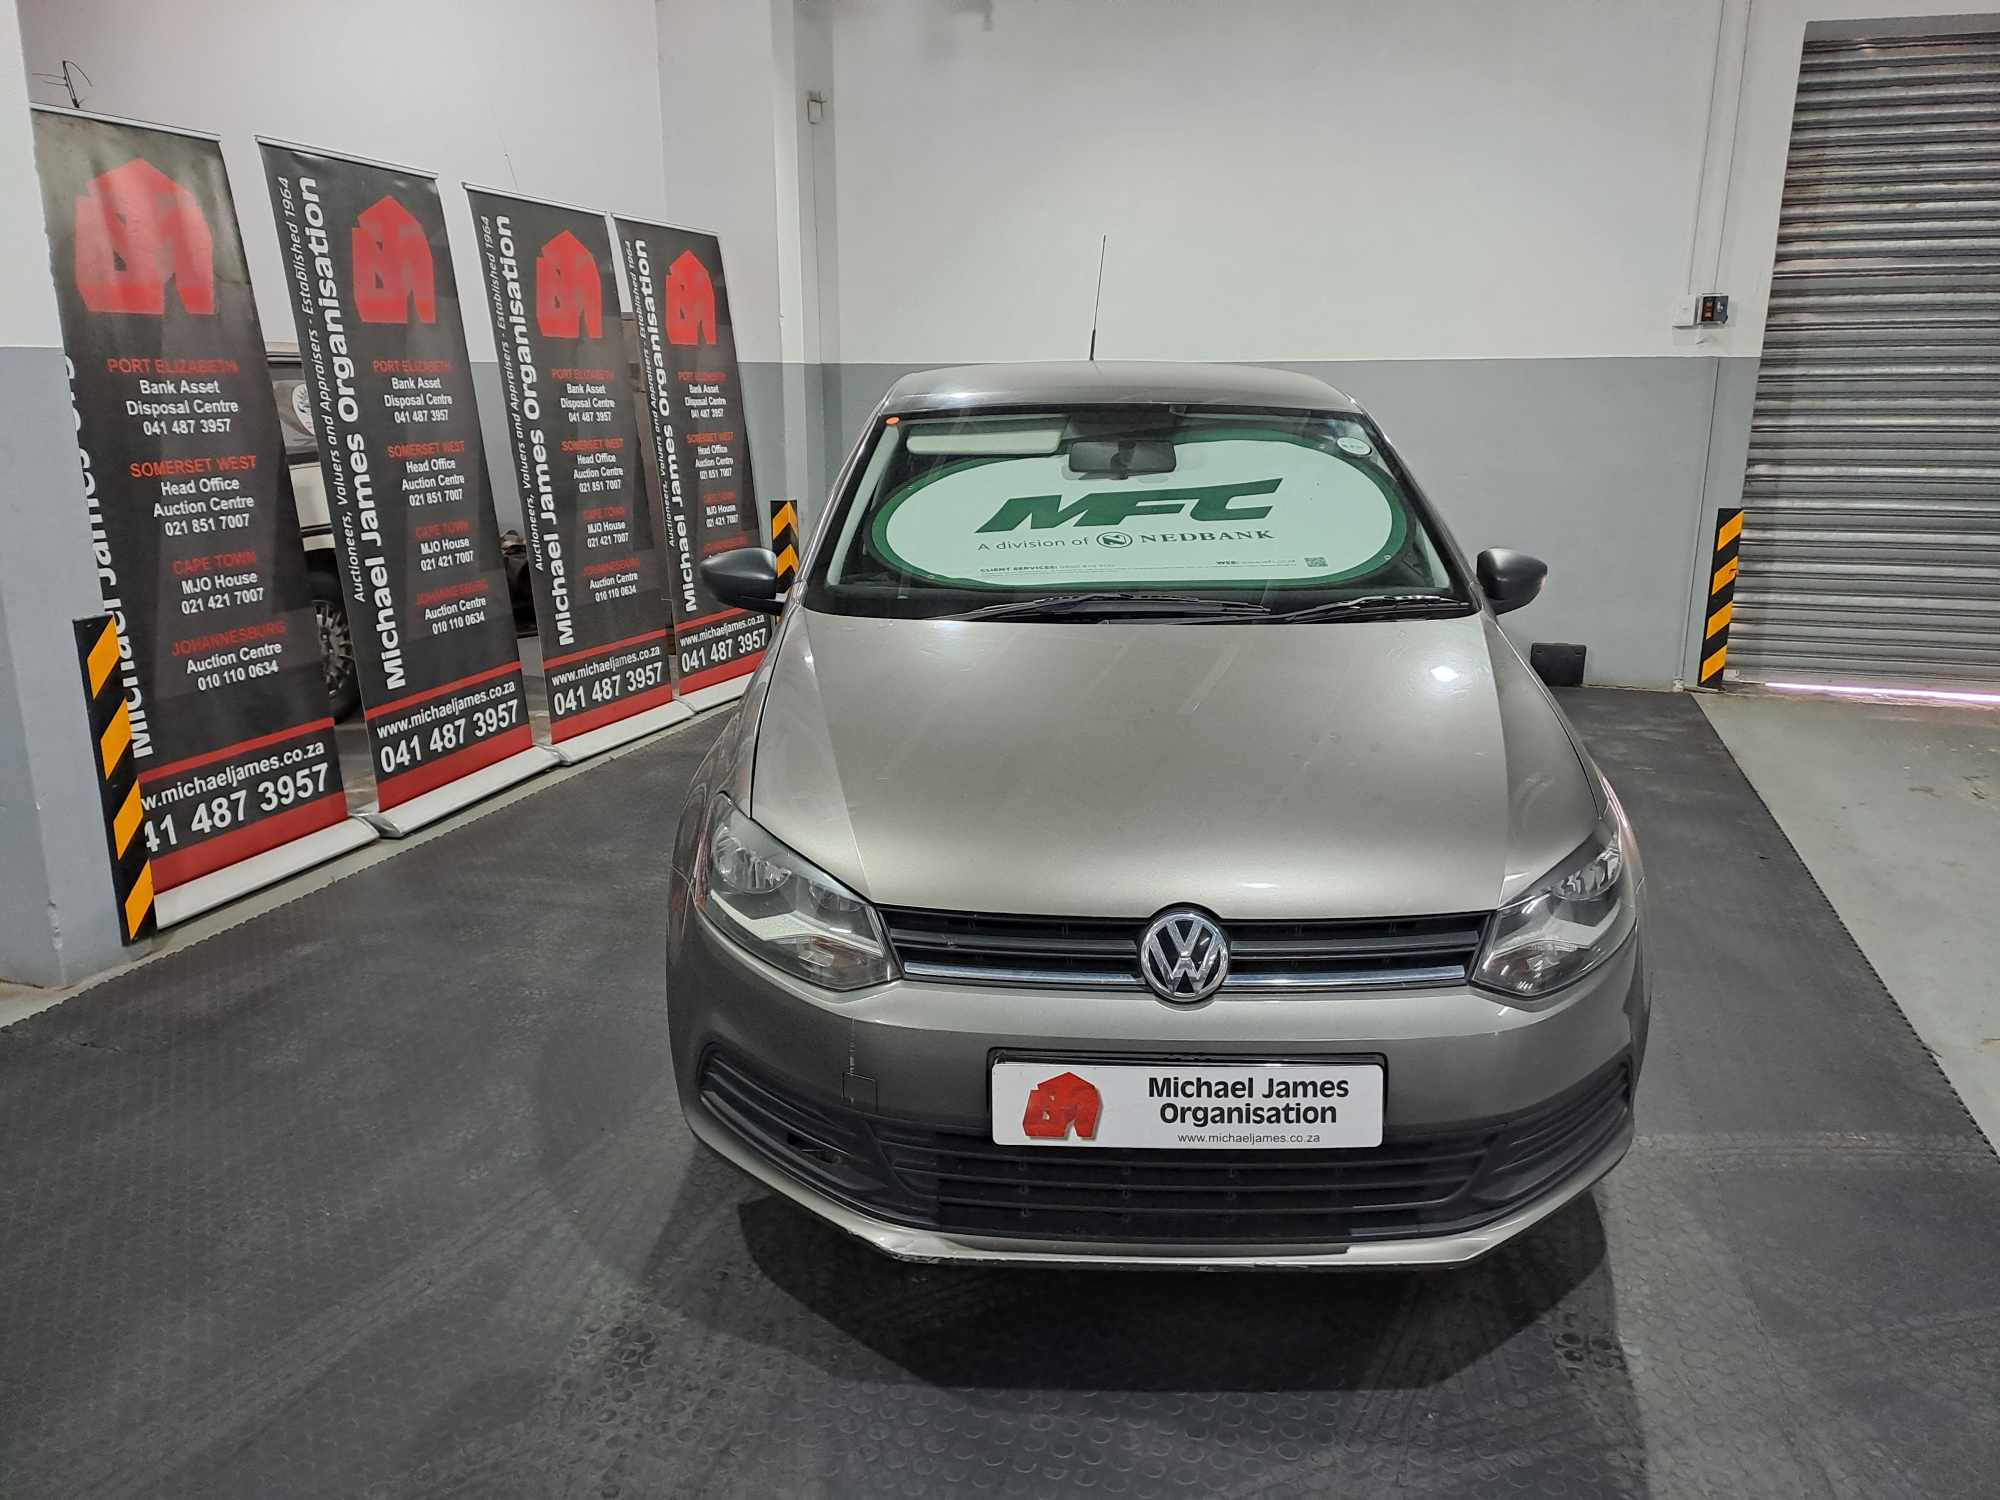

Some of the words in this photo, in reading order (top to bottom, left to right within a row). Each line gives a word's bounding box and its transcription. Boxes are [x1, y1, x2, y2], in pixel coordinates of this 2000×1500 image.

[277, 176, 296, 218] 1964
[288, 223, 314, 315] Established
[299, 177, 359, 423] Organisation
[496, 215, 540, 420] Organisation
[635, 239, 670, 416] Organisation
[106, 358, 150, 373] PORT
[309, 328, 332, 413] Appraisers
[140, 379, 177, 394] Bank
[180, 379, 220, 393] Asset
[391, 377, 416, 390] Bank
[418, 377, 442, 389] Asset
[566, 383, 584, 394] Bank
[586, 384, 606, 394] Asset
[126, 400, 190, 417] Disposal
[193, 399, 239, 414] Centre
[384, 393, 424, 409] Disposal
[426, 393, 453, 405] Centre
[143, 421, 168, 436] 041
[172, 420, 195, 434] 487
[200, 419, 231, 433] 3957
[322, 414, 337, 446] and
[394, 411, 411, 424] 041
[412, 410, 428, 422] 487
[430, 409, 449, 421] 3957
[512, 412, 524, 439] and
[129, 459, 212, 478] SOMERSET
[217, 455, 256, 471] WEST
[330, 450, 349, 506] Valuers
[406, 459, 429, 473] Head
[431, 457, 456, 471] Office
[518, 443, 531, 489] Valuers
[530, 428, 558, 525] James
[573, 469, 599, 480] Auction
[600, 467, 624, 477] Centre
[663, 424, 683, 507] James
[161, 480, 196, 496] Head
[200, 477, 240, 493] Office
[346, 433, 382, 547] James
[401, 476, 437, 491] Auction
[437, 473, 465, 487] Centre
[153, 500, 206, 518] Auction
[210, 496, 255, 512] Centre
[408, 493, 425, 507] 021
[427, 491, 442, 505] 851
[444, 488, 463, 502] 7007
[975, 478, 1283, 533] MFC
[164, 521, 188, 536] 021
[192, 518, 216, 534] 851
[220, 514, 250, 531] 7007
[420, 541, 441, 555] MJO
[442, 537, 470, 551] House
[978, 543, 990, 551] A
[996, 538, 1065, 550] division
[1072, 536, 1089, 546] of
[1140, 530, 1274, 544] NEDBANK
[340, 511, 366, 602] Auctioneers,
[420, 558, 436, 572] 021
[438, 554, 453, 568] 421
[454, 550, 474, 564] 7007
[673, 514, 697, 613] Michael
[182, 578, 211, 595] MJO
[215, 571, 258, 589] House
[543, 533, 575, 646] Michael
[589, 576, 615, 590] Auction
[616, 572, 639, 584] Centre
[181, 599, 204, 615] 021
[208, 595, 232, 612] 421
[234, 587, 264, 607] 7007
[424, 602, 458, 621] Auction
[459, 596, 487, 612] Centre
[364, 556, 407, 690] Michael
[432, 620, 448, 636] 010
[449, 615, 464, 631] 110
[464, 611, 485, 627] 0634
[680, 614, 764, 647] www.michaeljames.co.za
[186, 652, 236, 674] Auction
[239, 641, 283, 662] Centre
[681, 649, 706, 673] 041
[710, 638, 733, 663] 487
[738, 628, 766, 654] 3957
[198, 675, 220, 691] 010
[223, 668, 246, 686] 110
[249, 659, 279, 679] 0634
[551, 645, 660, 687] www.michaeljames.co.za
[553, 685, 586, 716] 041
[592, 674, 621, 702] 487
[626, 661, 663, 692] 3957
[376, 680, 516, 740] www.michaeljames.co.za
[380, 734, 422, 773] 041
[429, 718, 466, 754] 487
[472, 699, 518, 738] 3957
[143, 742, 325, 811] w.michaeljames.co.za
[144, 814, 178, 852] 41
[191, 789, 248, 834] 487
[257, 761, 328, 812] 3957
[1148, 1076, 1254, 1099] Michael
[1262, 1077, 1350, 1100] James
[1159, 1102, 1337, 1128] Organisation
[1177, 1132, 1320, 1145] www.michaeljames.co.za
